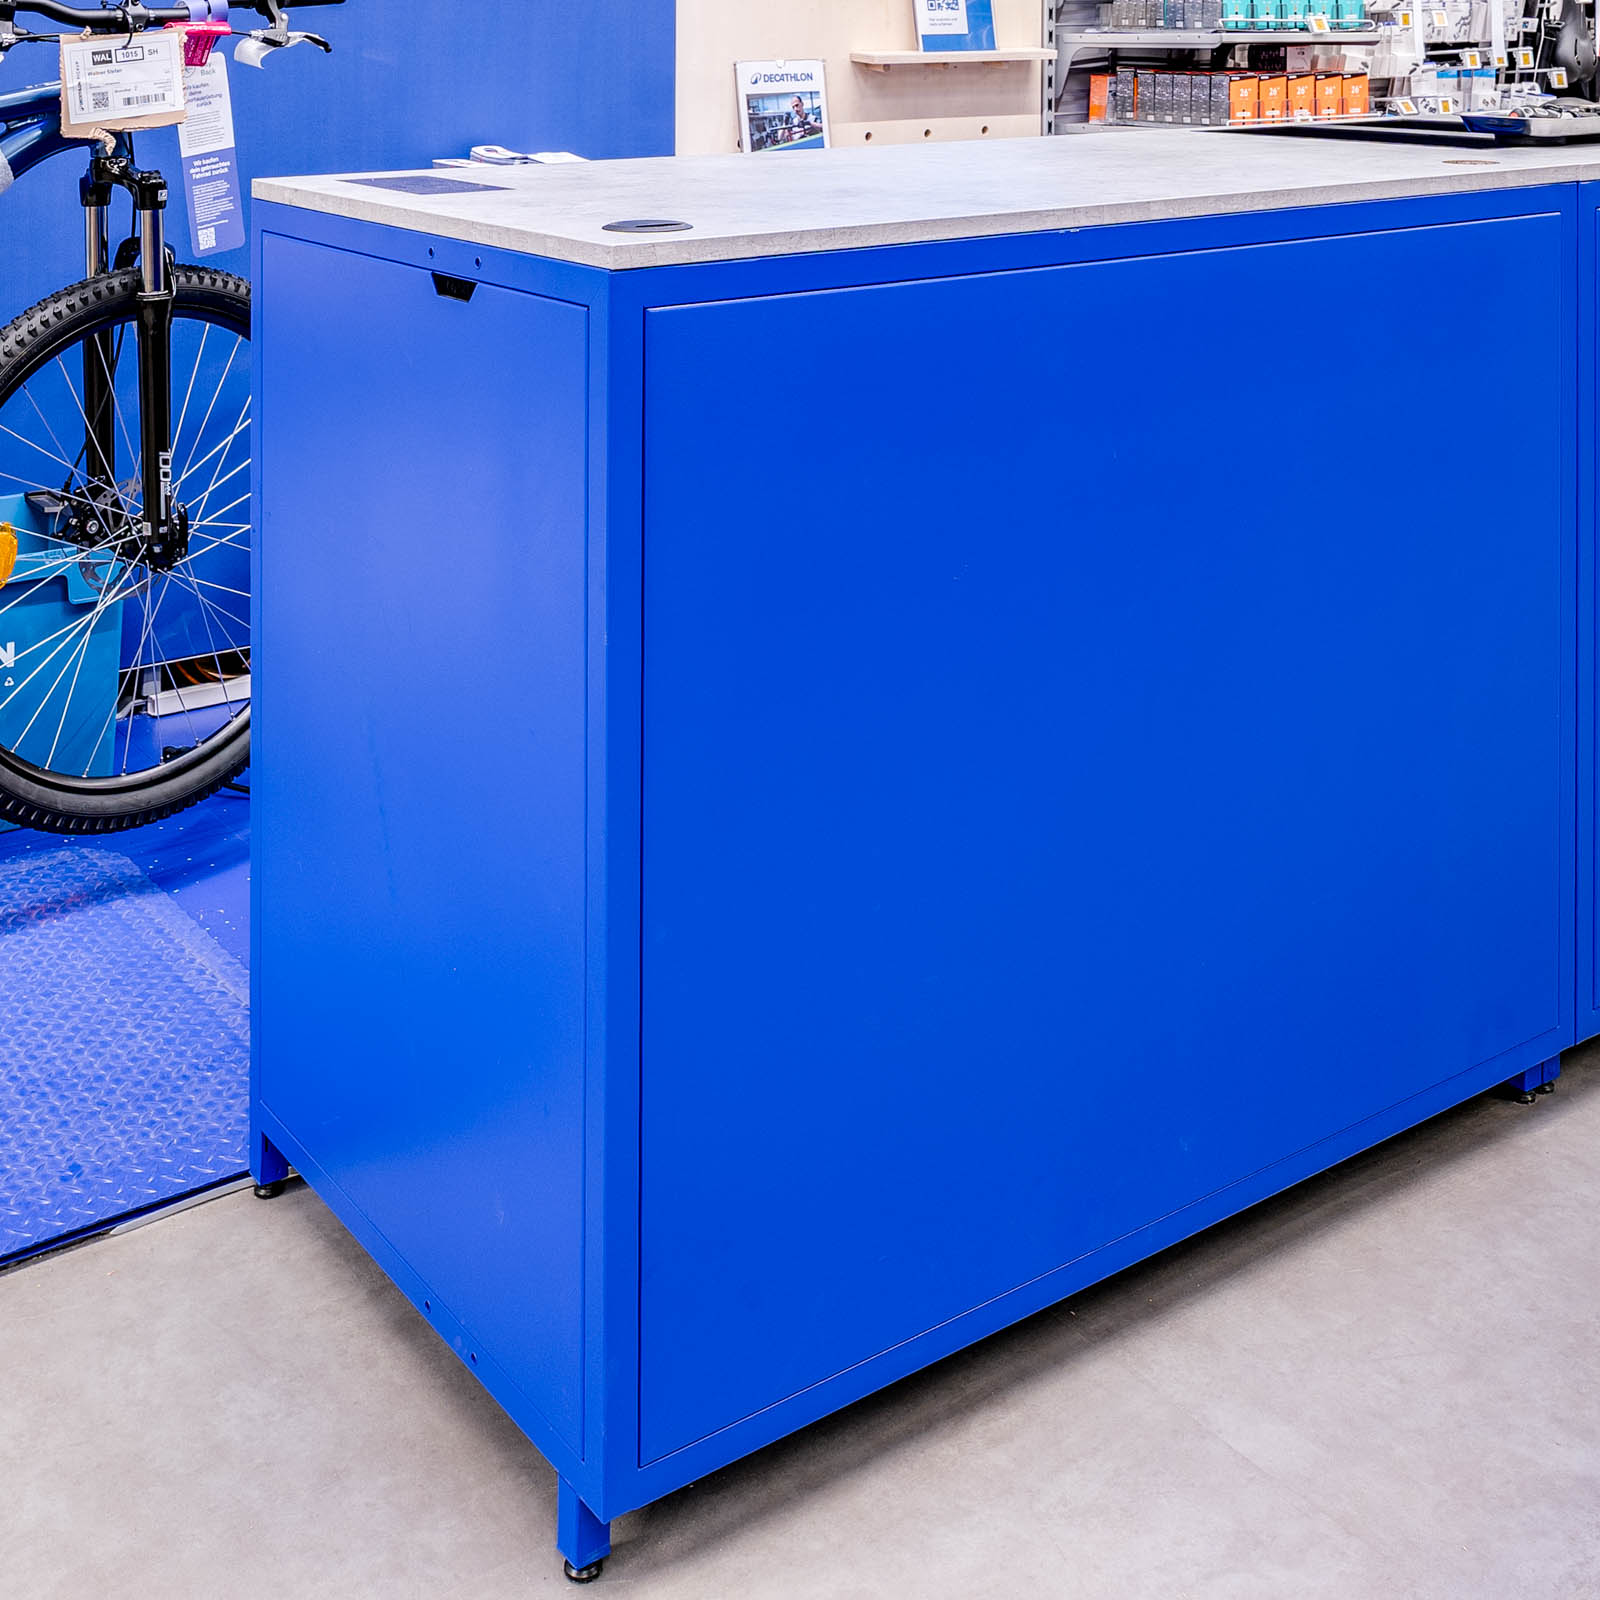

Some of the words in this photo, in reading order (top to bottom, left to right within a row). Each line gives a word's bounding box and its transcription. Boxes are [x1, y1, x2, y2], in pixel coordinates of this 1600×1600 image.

[92, 53, 112, 63] WAL
[121, 50, 139, 59] 1015
[147, 48, 159, 56] SH
[763, 72, 814, 83] DECATHLON
[158, 448, 172, 481] 100
